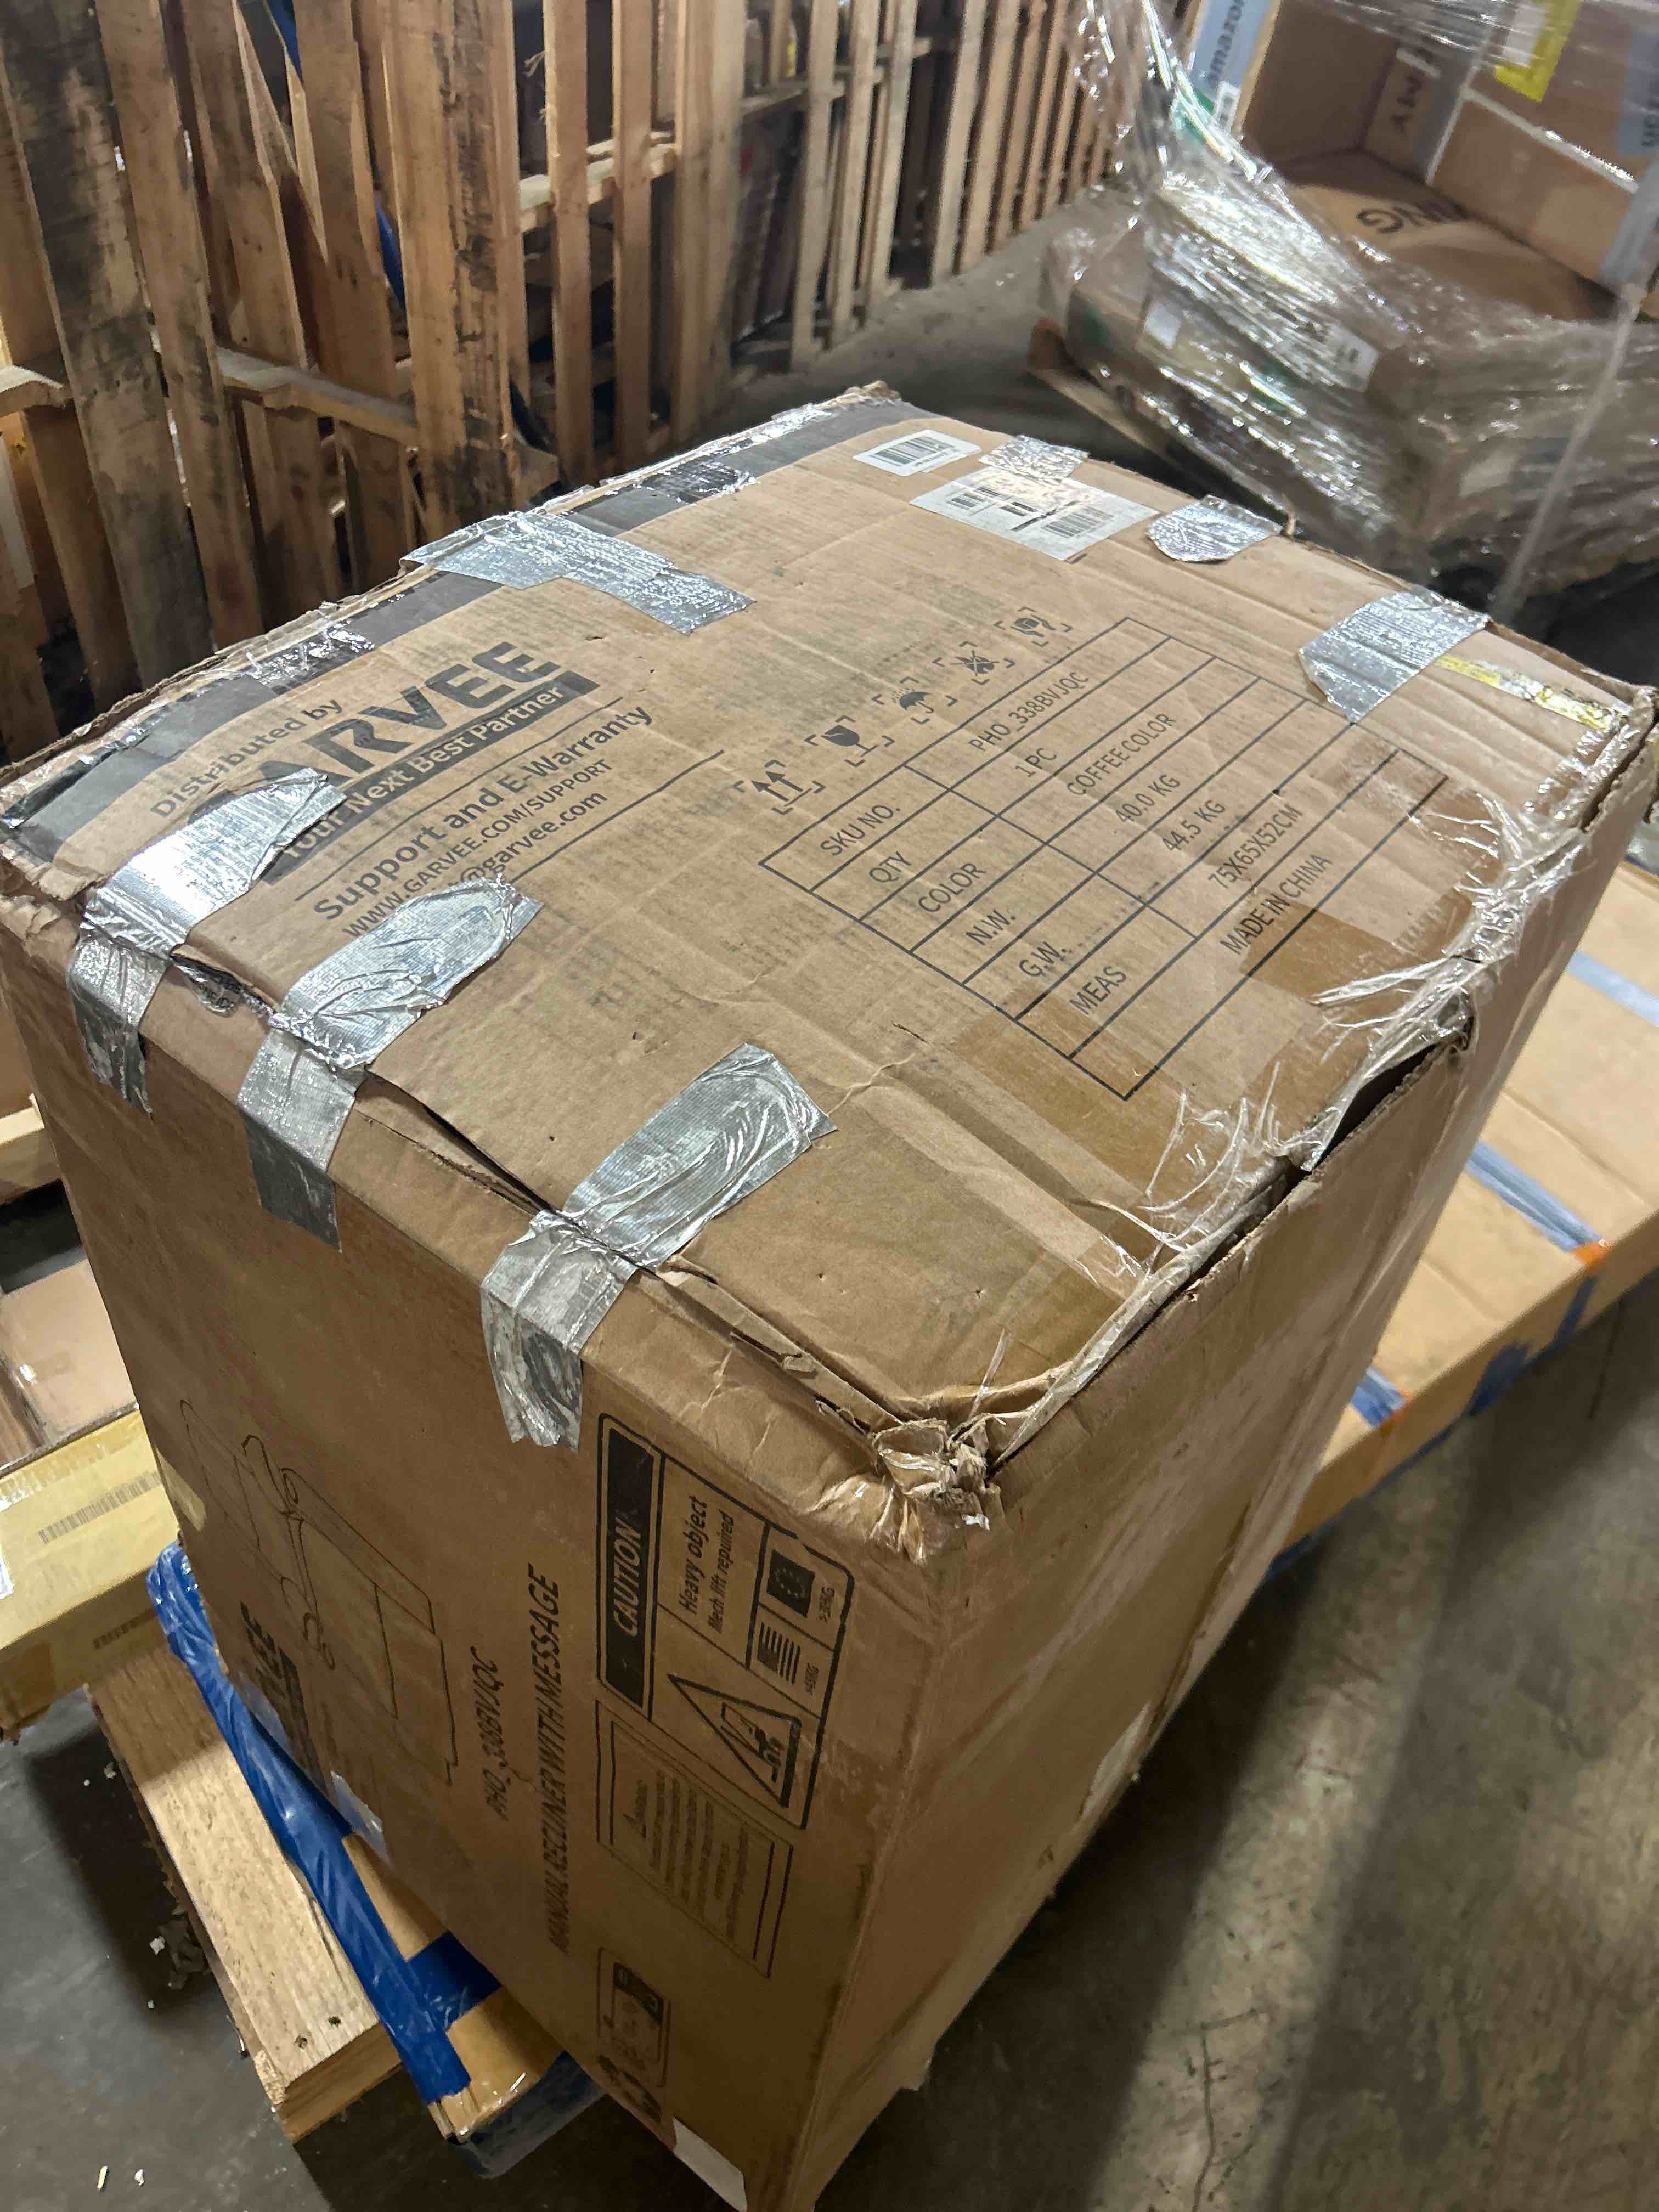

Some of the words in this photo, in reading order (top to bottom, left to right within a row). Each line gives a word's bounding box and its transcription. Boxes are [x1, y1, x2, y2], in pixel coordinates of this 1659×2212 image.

[150, 716, 307, 817] Distributed
[302, 699, 343, 720] by
[346, 769, 415, 815] Next
[410, 736, 476, 774] Best
[474, 684, 564, 741] Partner
[820, 823, 866, 856] SKU
[857, 804, 901, 830] NO.
[968, 672, 1089, 752] PHO_338BVJQC
[1015, 763, 1036, 778] 1
[1024, 747, 1058, 769] PC
[314, 825, 447, 920] Support
[443, 787, 505, 829] and
[497, 706, 652, 794] E-Warranty
[342, 759, 613, 938] WWW.GARVEE.COM/SUPPORT
[447, 790, 608, 887] @garvee.com
[869, 851, 912, 884] QTY
[965, 909, 1017, 946] N.W.
[1115, 793, 1155, 823] 40.0
[1147, 774, 1181, 797] KG
[918, 863, 987, 913] COLOR
[1018, 941, 1067, 977] G.W.
[1162, 820, 1202, 851] 44.5
[1194, 799, 1227, 823] KG
[1069, 964, 1127, 1015] MEAS
[1208, 804, 1304, 889] 75X65X52CM
[1220, 907, 1274, 955] MADE
[1261, 893, 1291, 917] IN
[1279, 853, 1334, 899] CHINA
[613, 1517, 641, 1637] CAUTION
[682, 1495, 709, 1559] object
[527, 1562, 563, 1709] MESSAGE
[678, 1558, 706, 1616] Heavy
